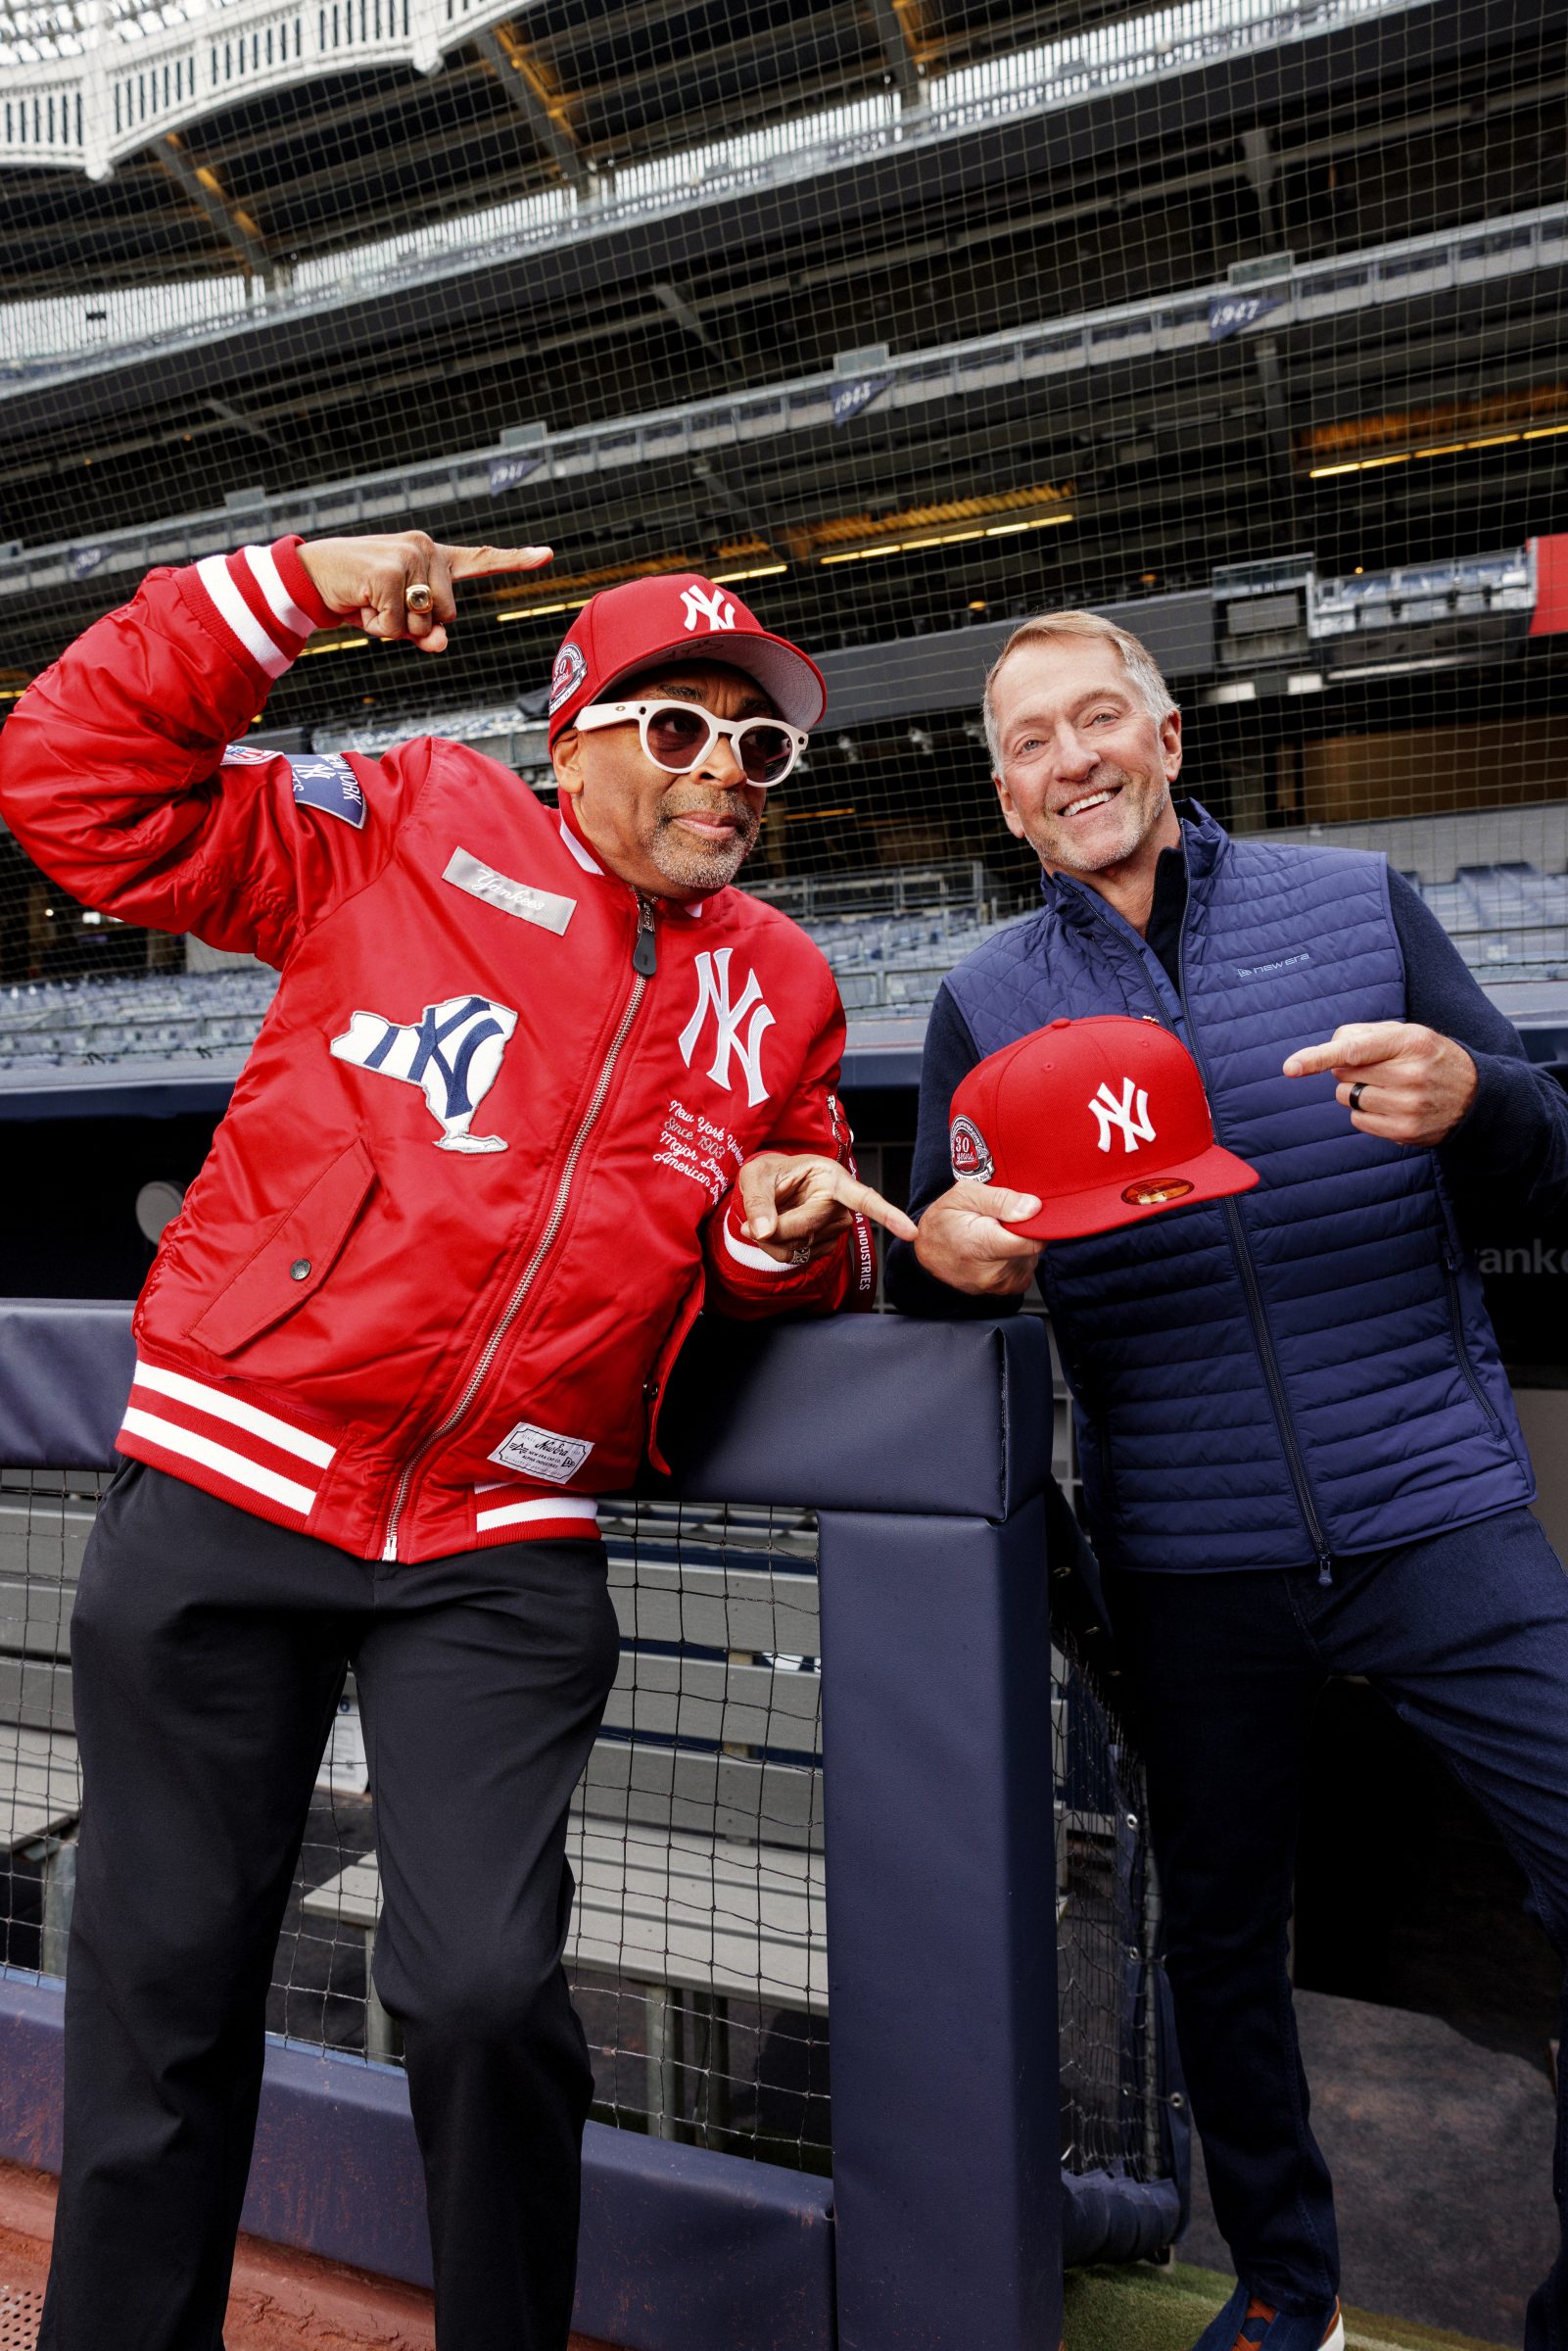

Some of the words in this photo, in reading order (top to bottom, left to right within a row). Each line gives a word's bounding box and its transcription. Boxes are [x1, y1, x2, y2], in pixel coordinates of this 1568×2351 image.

[680, 584, 736, 631] NY
[337, 771, 362, 806] YORK
[471, 869, 546, 910] Yankees
[1254, 961, 1283, 974] new
[1284, 952, 1310, 966] era
[678, 947, 776, 1108] NY
[668, 1100, 694, 1124] New
[697, 1116, 725, 1141] York
[1088, 1077, 1157, 1153] NY
[659, 1130, 698, 1161] Major
[665, 1117, 693, 1140] Since
[697, 1135, 726, 1160] 1903
[955, 1135, 970, 1153] 30
[653, 1152, 710, 1187] American
[858, 1226, 872, 1291] INDUSTRIES
[535, 1439, 556, 1453] New
[556, 1443, 569, 1457] Era
